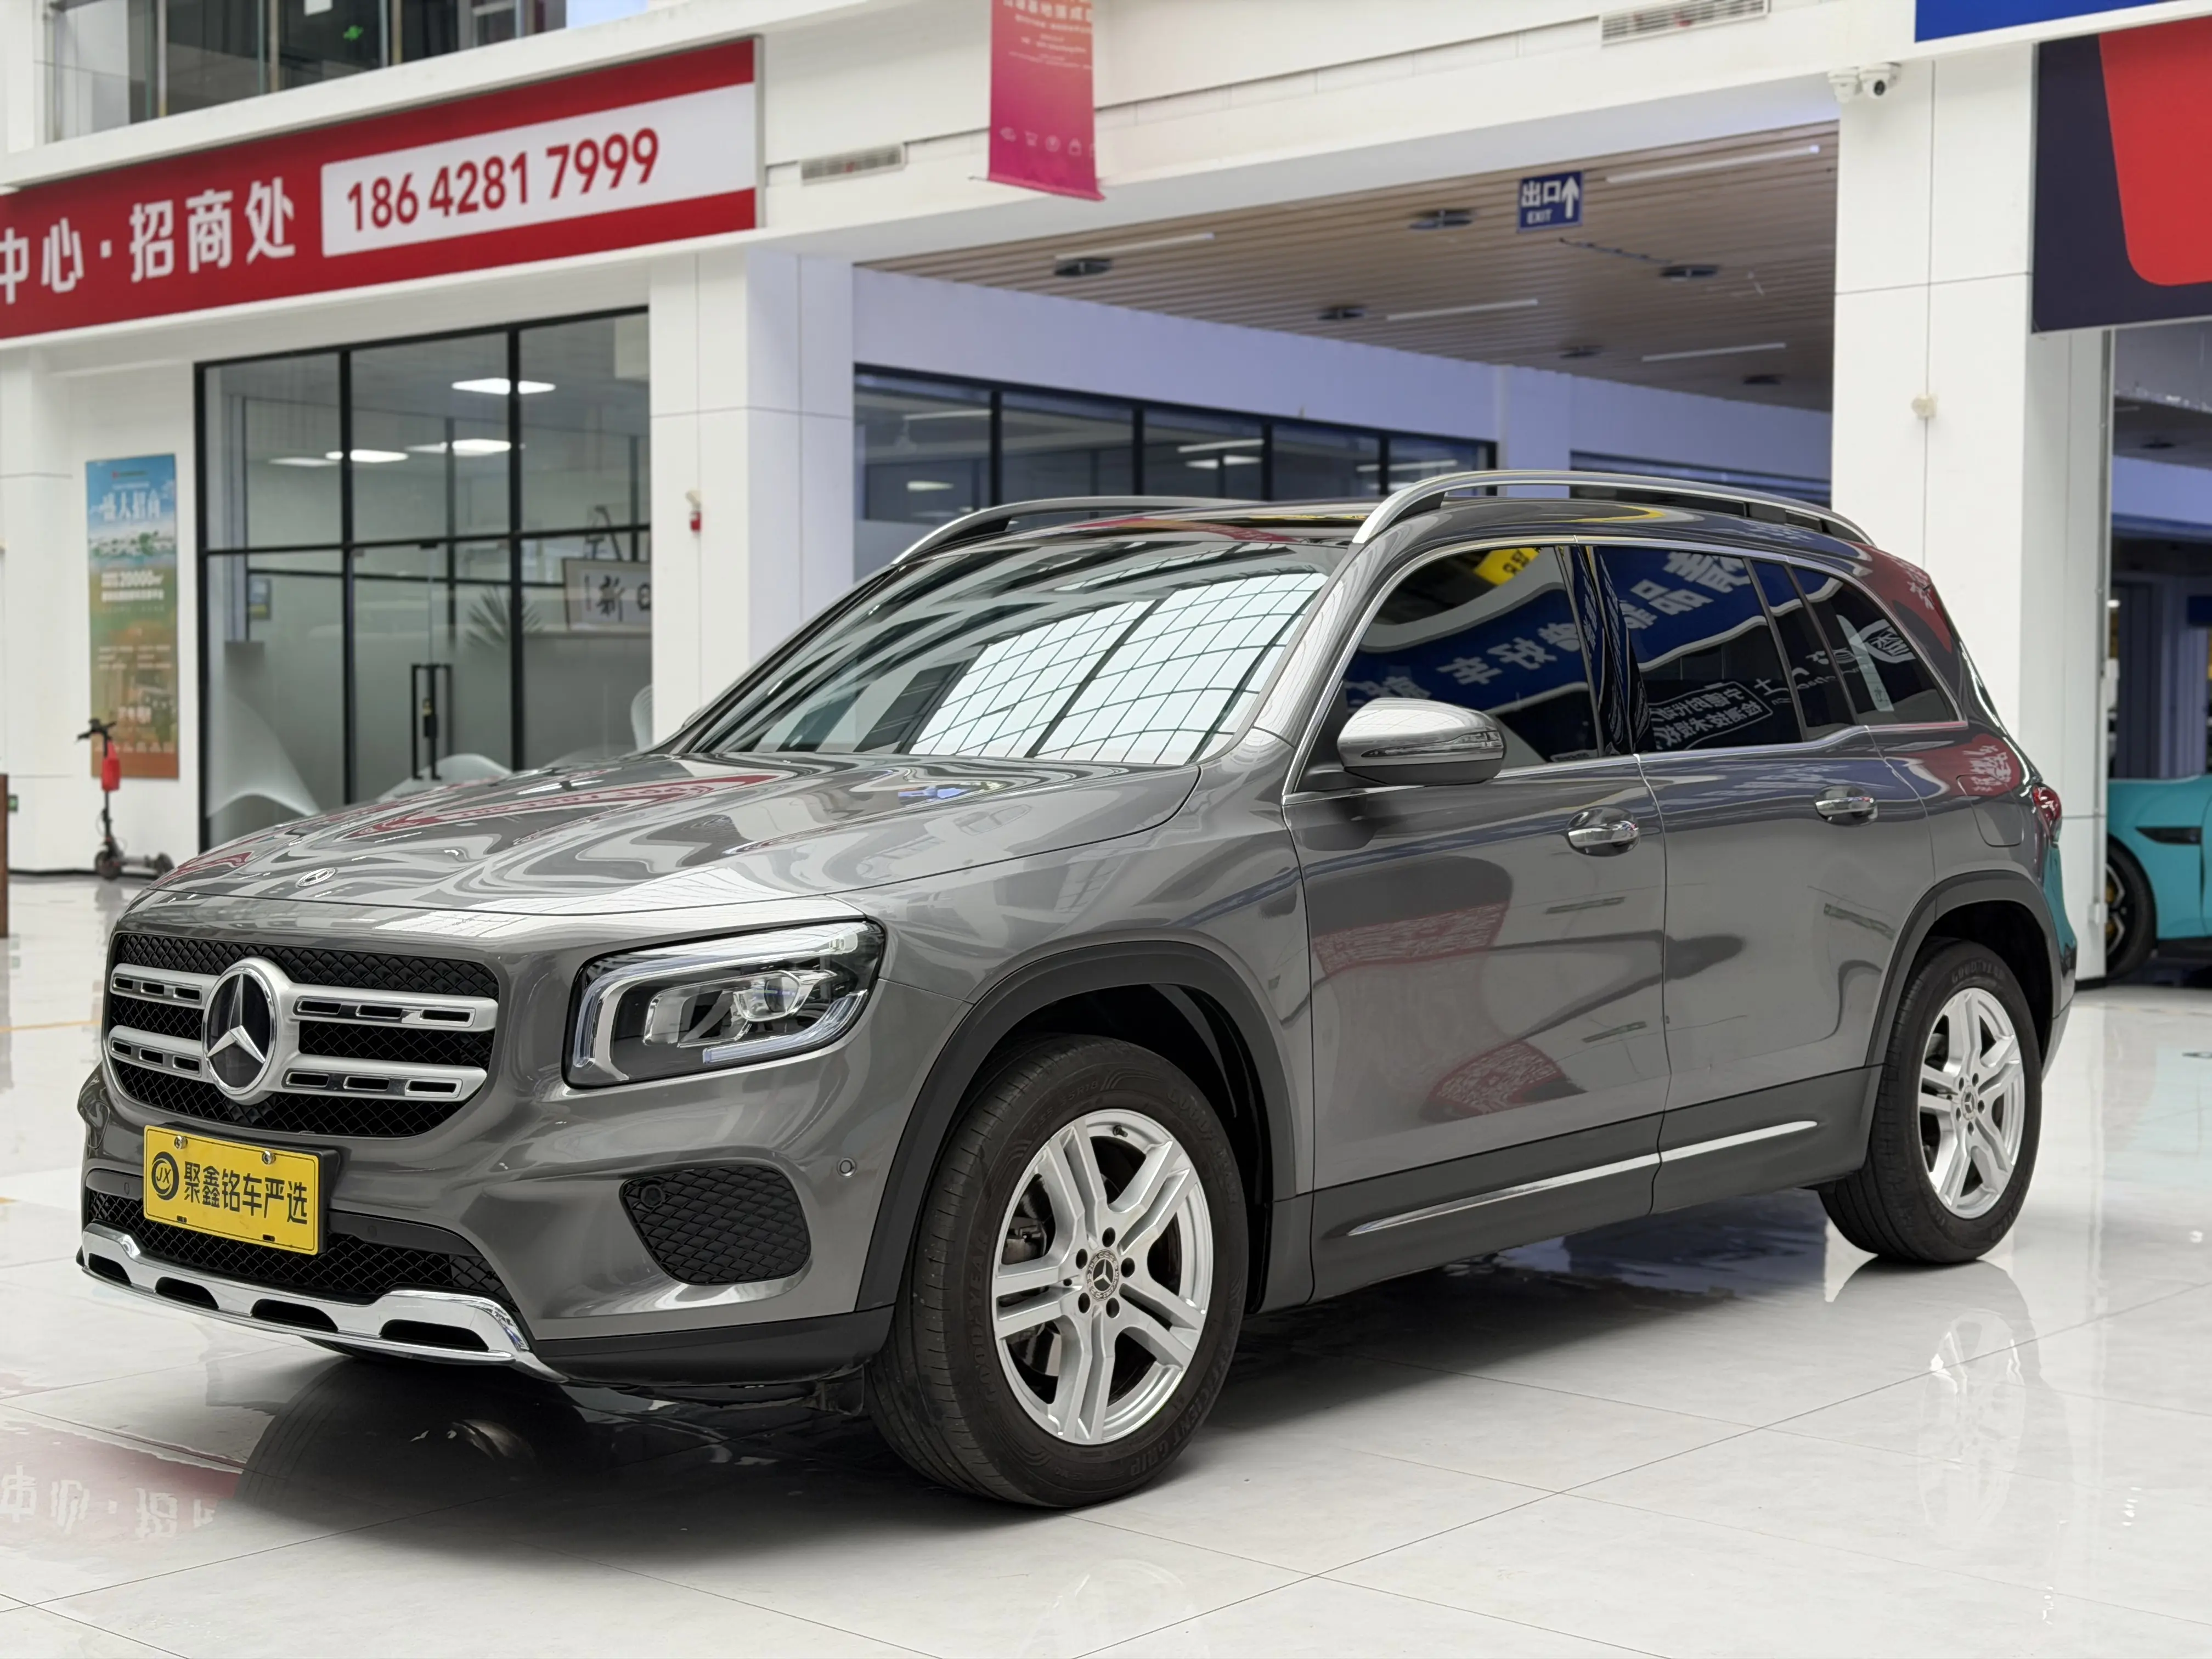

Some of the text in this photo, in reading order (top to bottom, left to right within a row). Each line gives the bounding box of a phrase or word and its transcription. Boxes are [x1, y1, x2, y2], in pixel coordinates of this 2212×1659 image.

[347, 127, 659, 232] 186 4281 7999
[1521, 181, 1562, 208] 出口
[156, 1167, 172, 1184] JX
[184, 1160, 308, 1225] 聚鑫铭车严选
